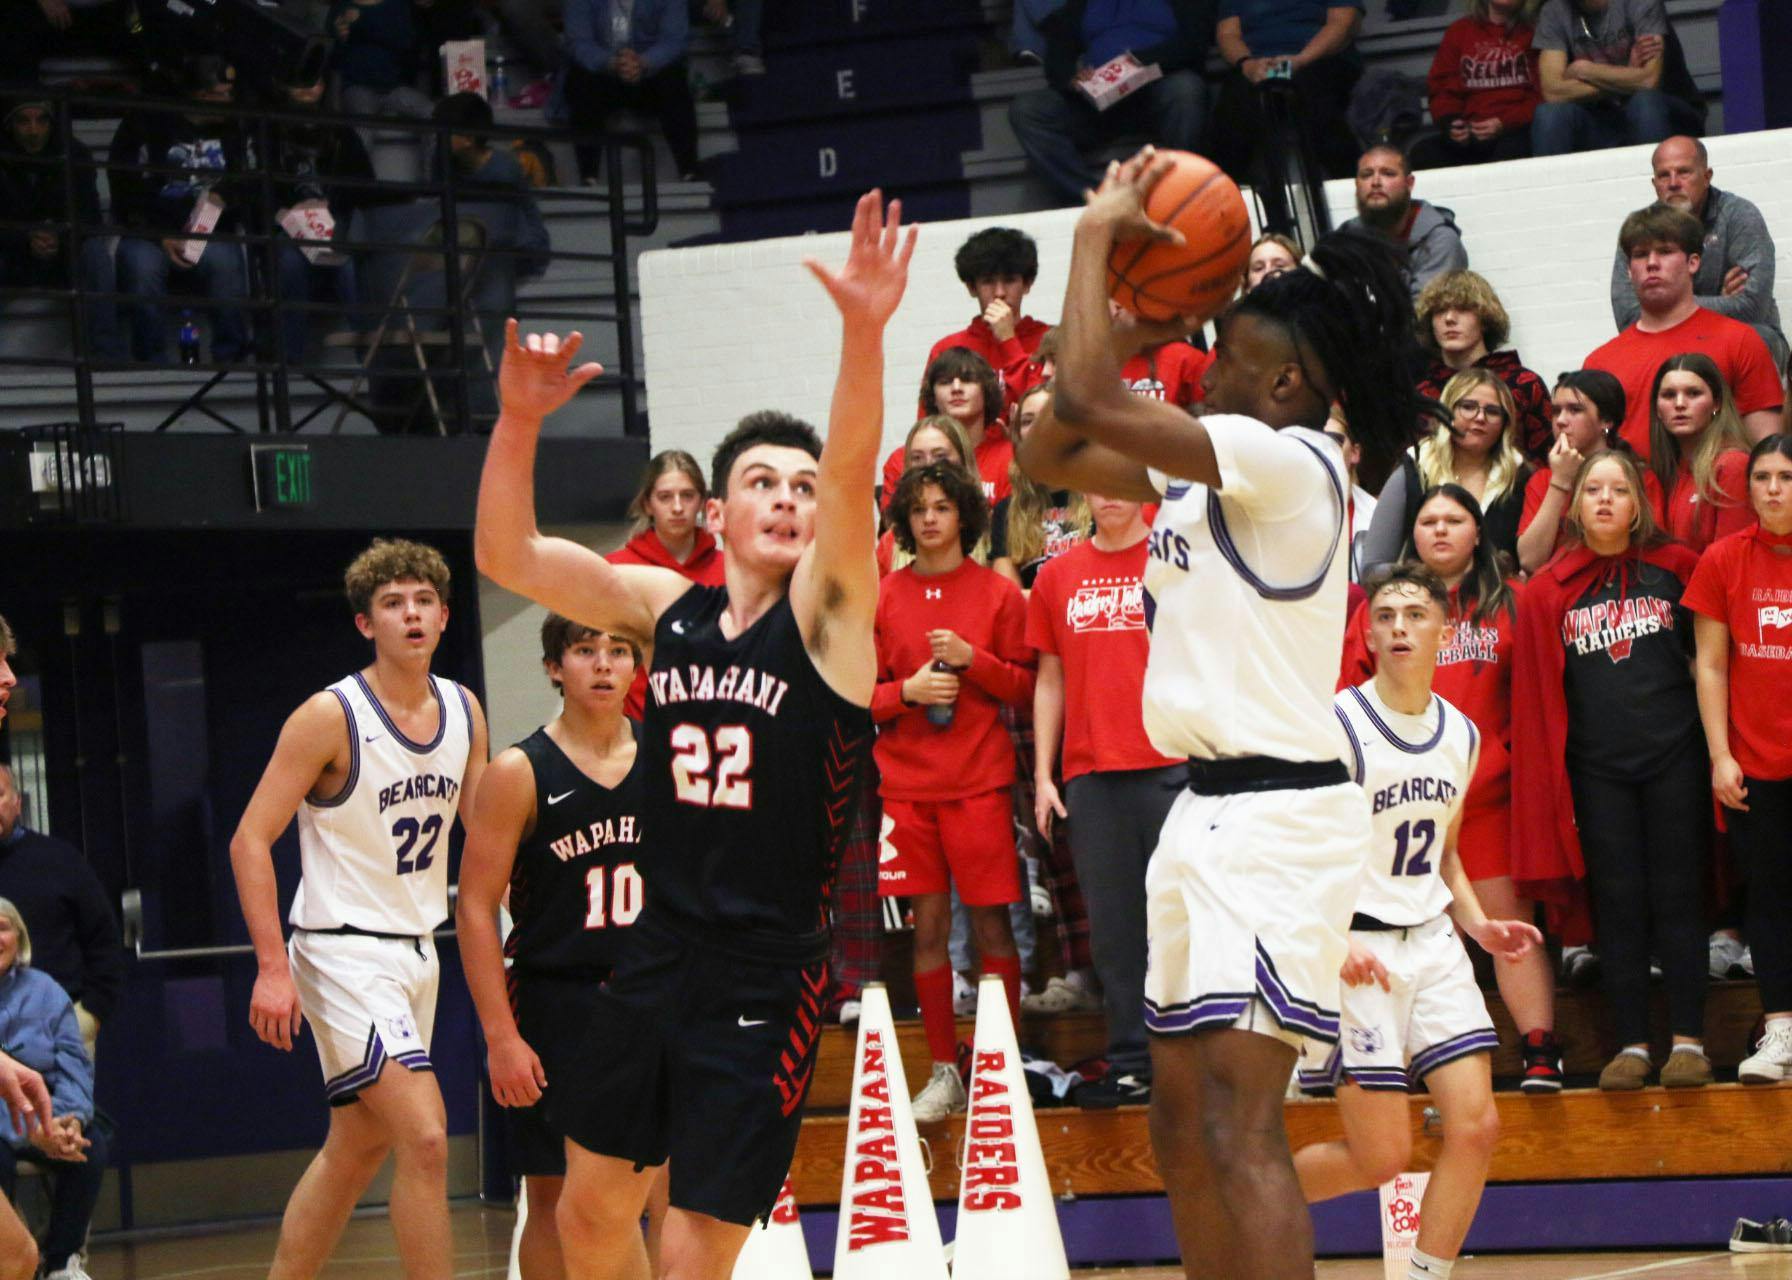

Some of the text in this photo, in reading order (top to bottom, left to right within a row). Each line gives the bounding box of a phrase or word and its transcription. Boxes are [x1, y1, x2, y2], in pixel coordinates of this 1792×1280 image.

[837, 69, 856, 99] E
[1460, 51, 1531, 82] SELMA
[819, 147, 838, 178] D
[276, 451, 311, 503] EXIT
[1562, 595, 1674, 646] WAPAHANI
[1575, 615, 1661, 656] RAIDERS
[649, 664, 789, 716] WAPAHANI
[671, 722, 752, 810] 22
[379, 773, 459, 815] BEARCATS
[1372, 776, 1457, 815] BEARCATS
[391, 813, 443, 876] 22
[1391, 818, 1436, 876] 12
[583, 862, 647, 930] 10
[848, 1030, 911, 1252] WAPAHANI
[963, 1050, 1022, 1212] RAIDERS
[1389, 1198, 1413, 1218] POP
[1393, 1213, 1420, 1232] CORN
